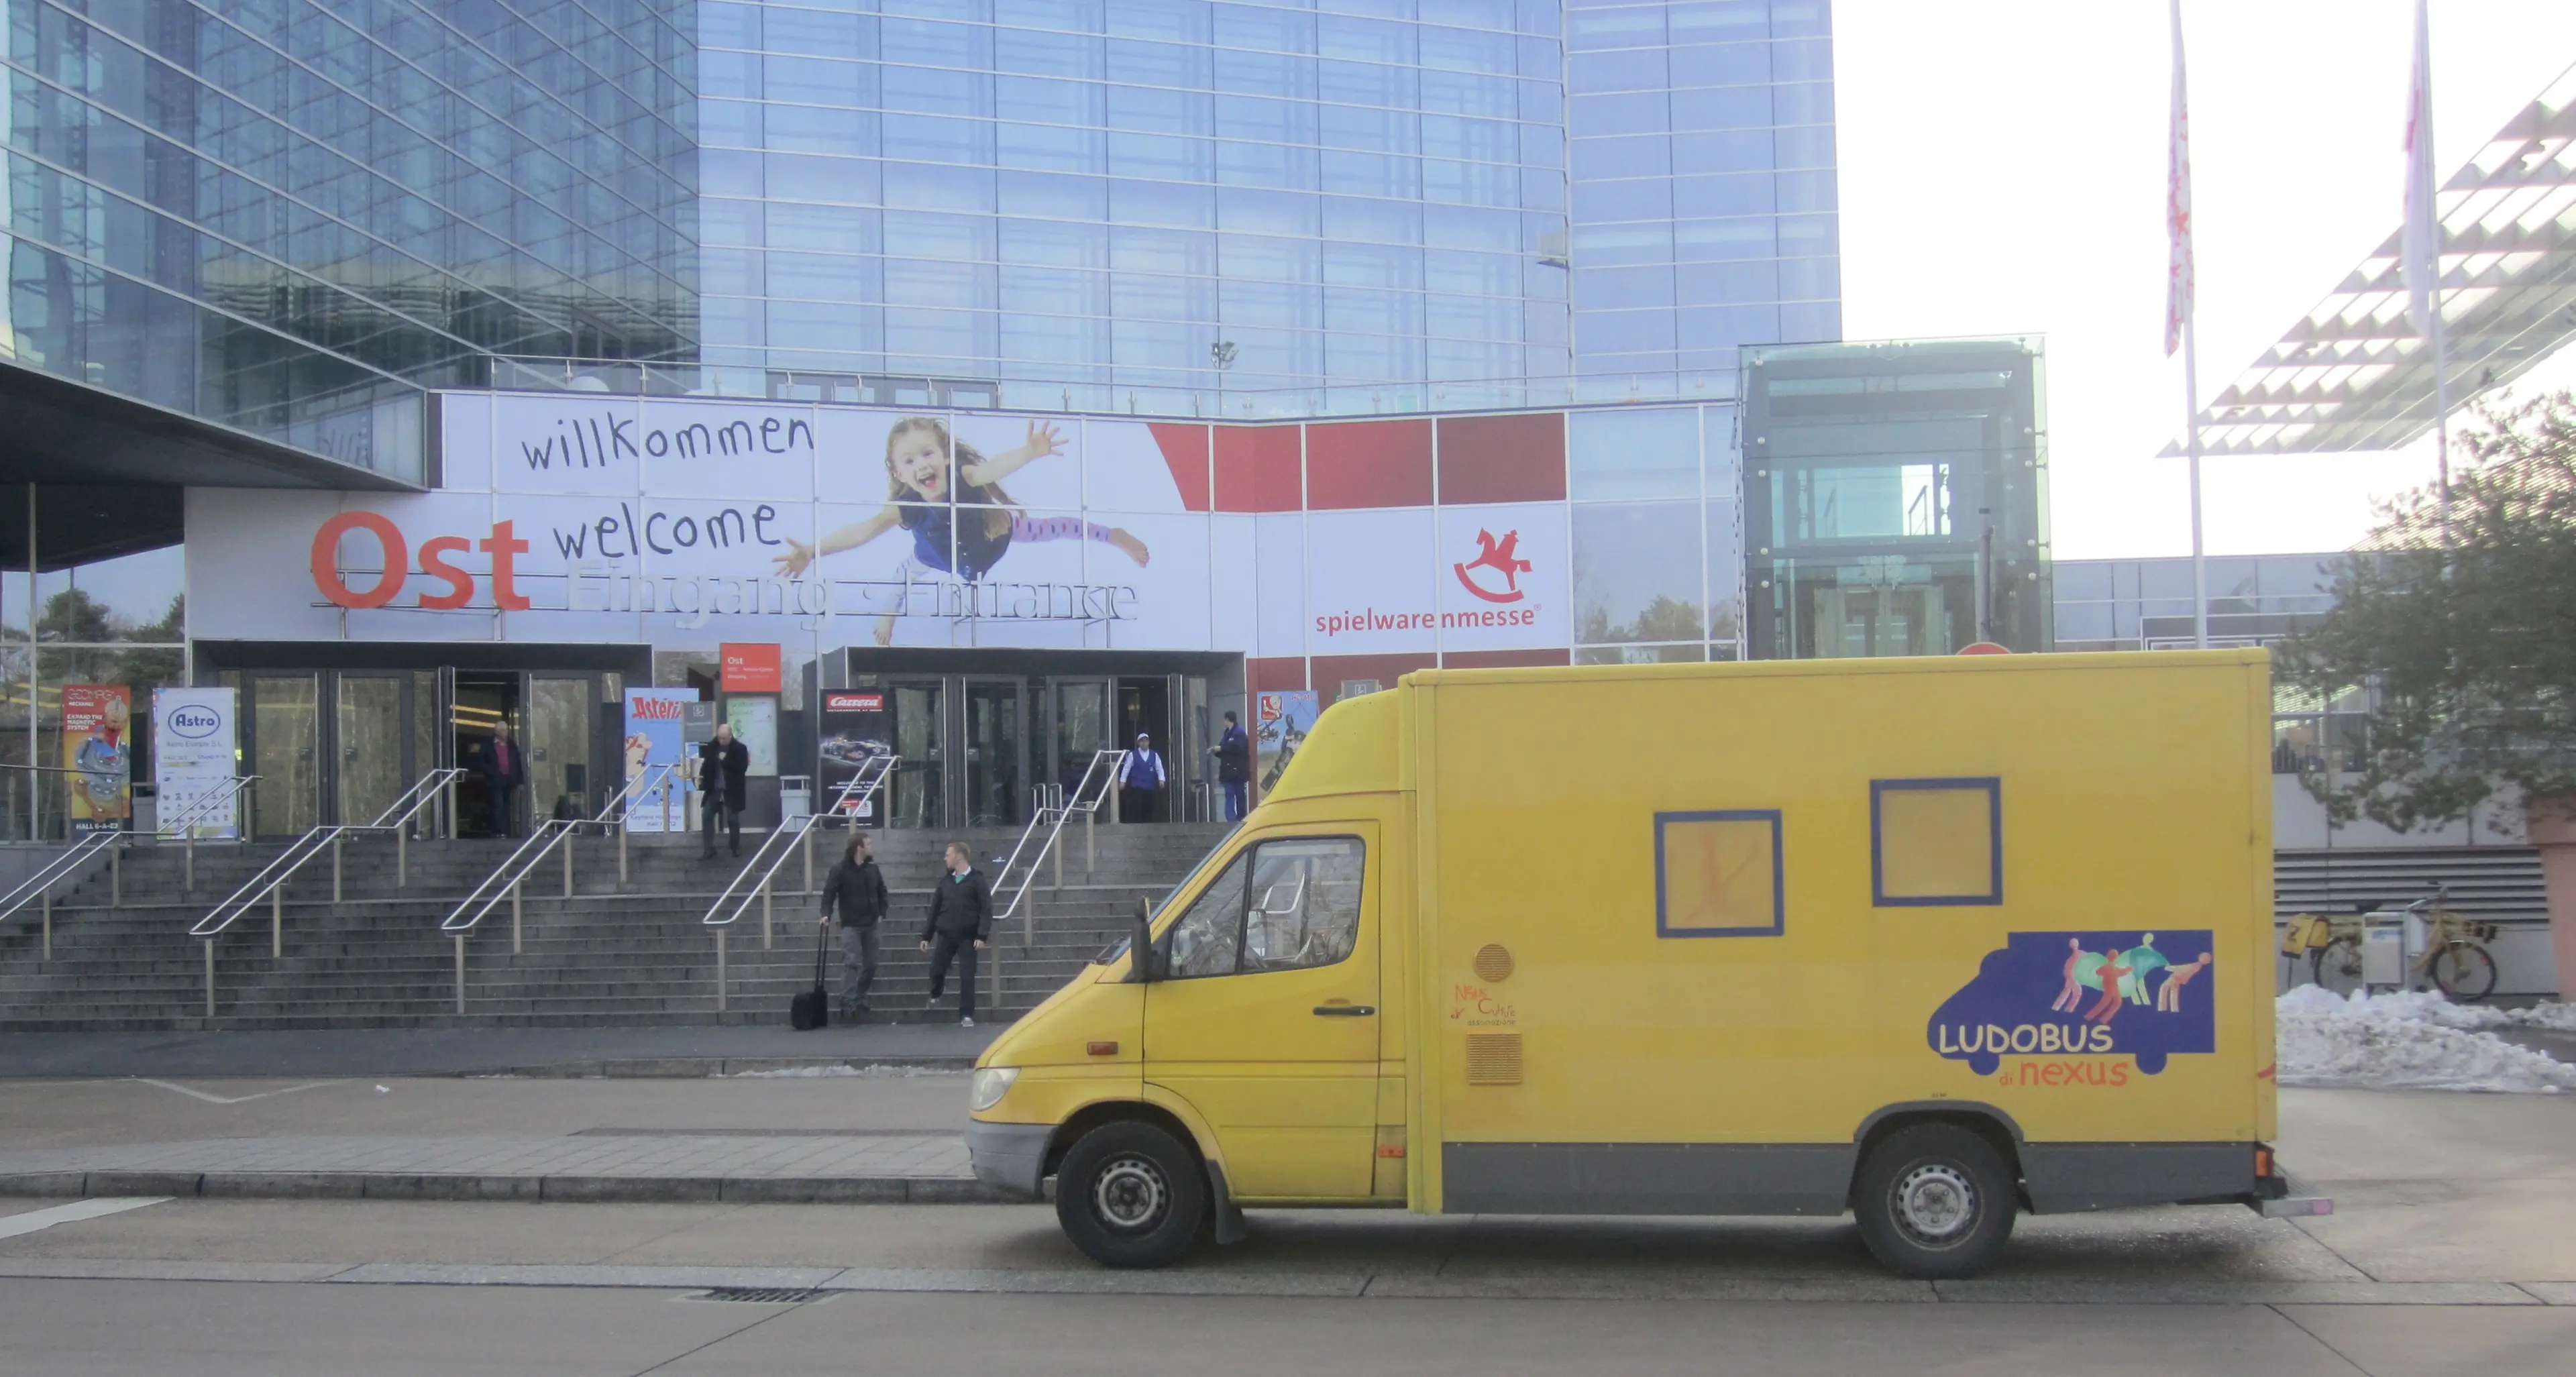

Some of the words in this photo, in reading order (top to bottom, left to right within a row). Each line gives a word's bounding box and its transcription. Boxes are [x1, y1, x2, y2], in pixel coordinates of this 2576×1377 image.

[522, 412, 814, 470] willkommen
[553, 502, 782, 560] welcome
[311, 510, 531, 610] Ost
[566, 560, 836, 630] Eingang
[904, 570, 1139, 620] Entrance
[727, 657, 744, 665] Ost
[830, 697, 879, 707] Carrera
[176, 714, 215, 726] Astro
[1467, 1018, 1516, 1026] associazione
[1939, 1023, 2114, 1054] LUDOBUS
[1999, 1073, 2012, 1087] di
[2019, 1060, 2129, 1087] nexus
